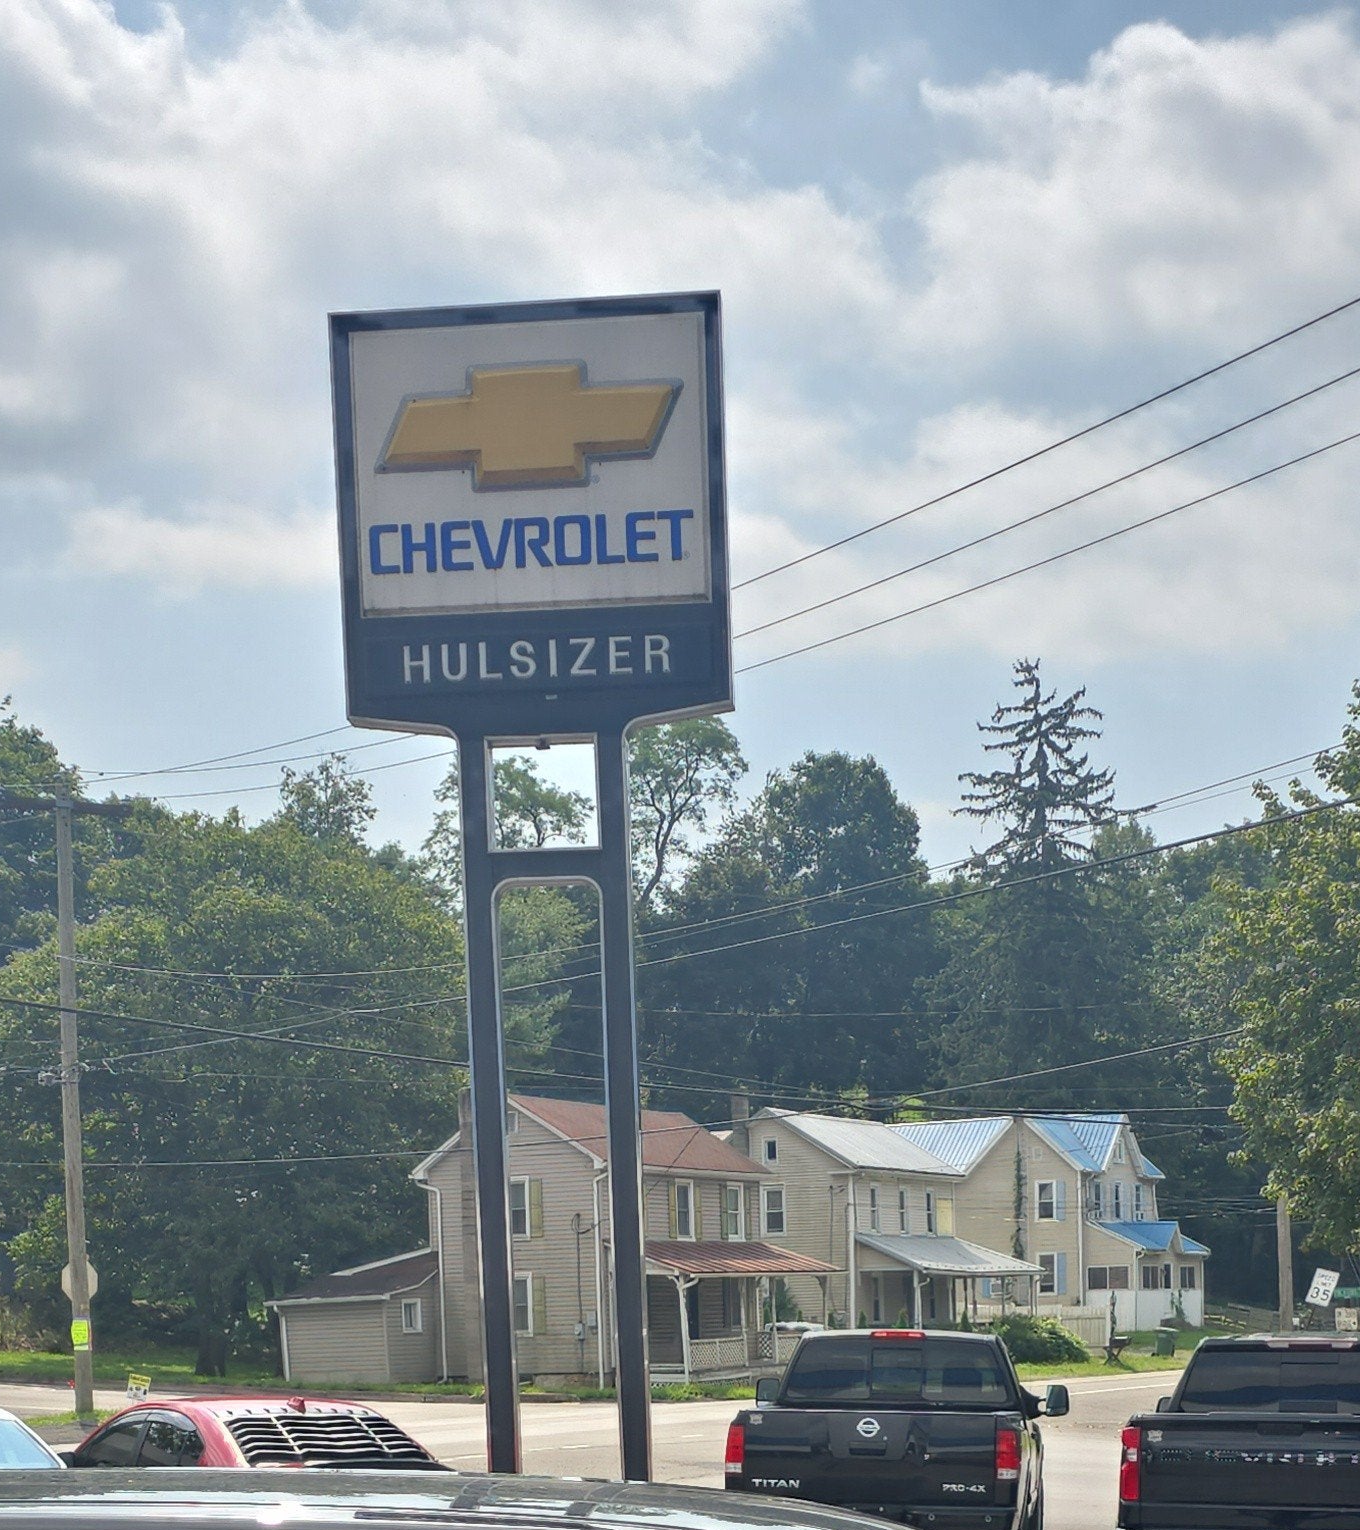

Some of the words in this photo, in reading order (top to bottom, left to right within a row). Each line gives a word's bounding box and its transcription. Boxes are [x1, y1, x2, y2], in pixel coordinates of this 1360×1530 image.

[368, 508, 694, 576] CHEVROLET
[402, 633, 672, 684] HULSIZER
[1310, 1286, 1331, 1301] 35
[751, 1478, 800, 1489] TITAN
[942, 1483, 986, 1493] PRO-4X
